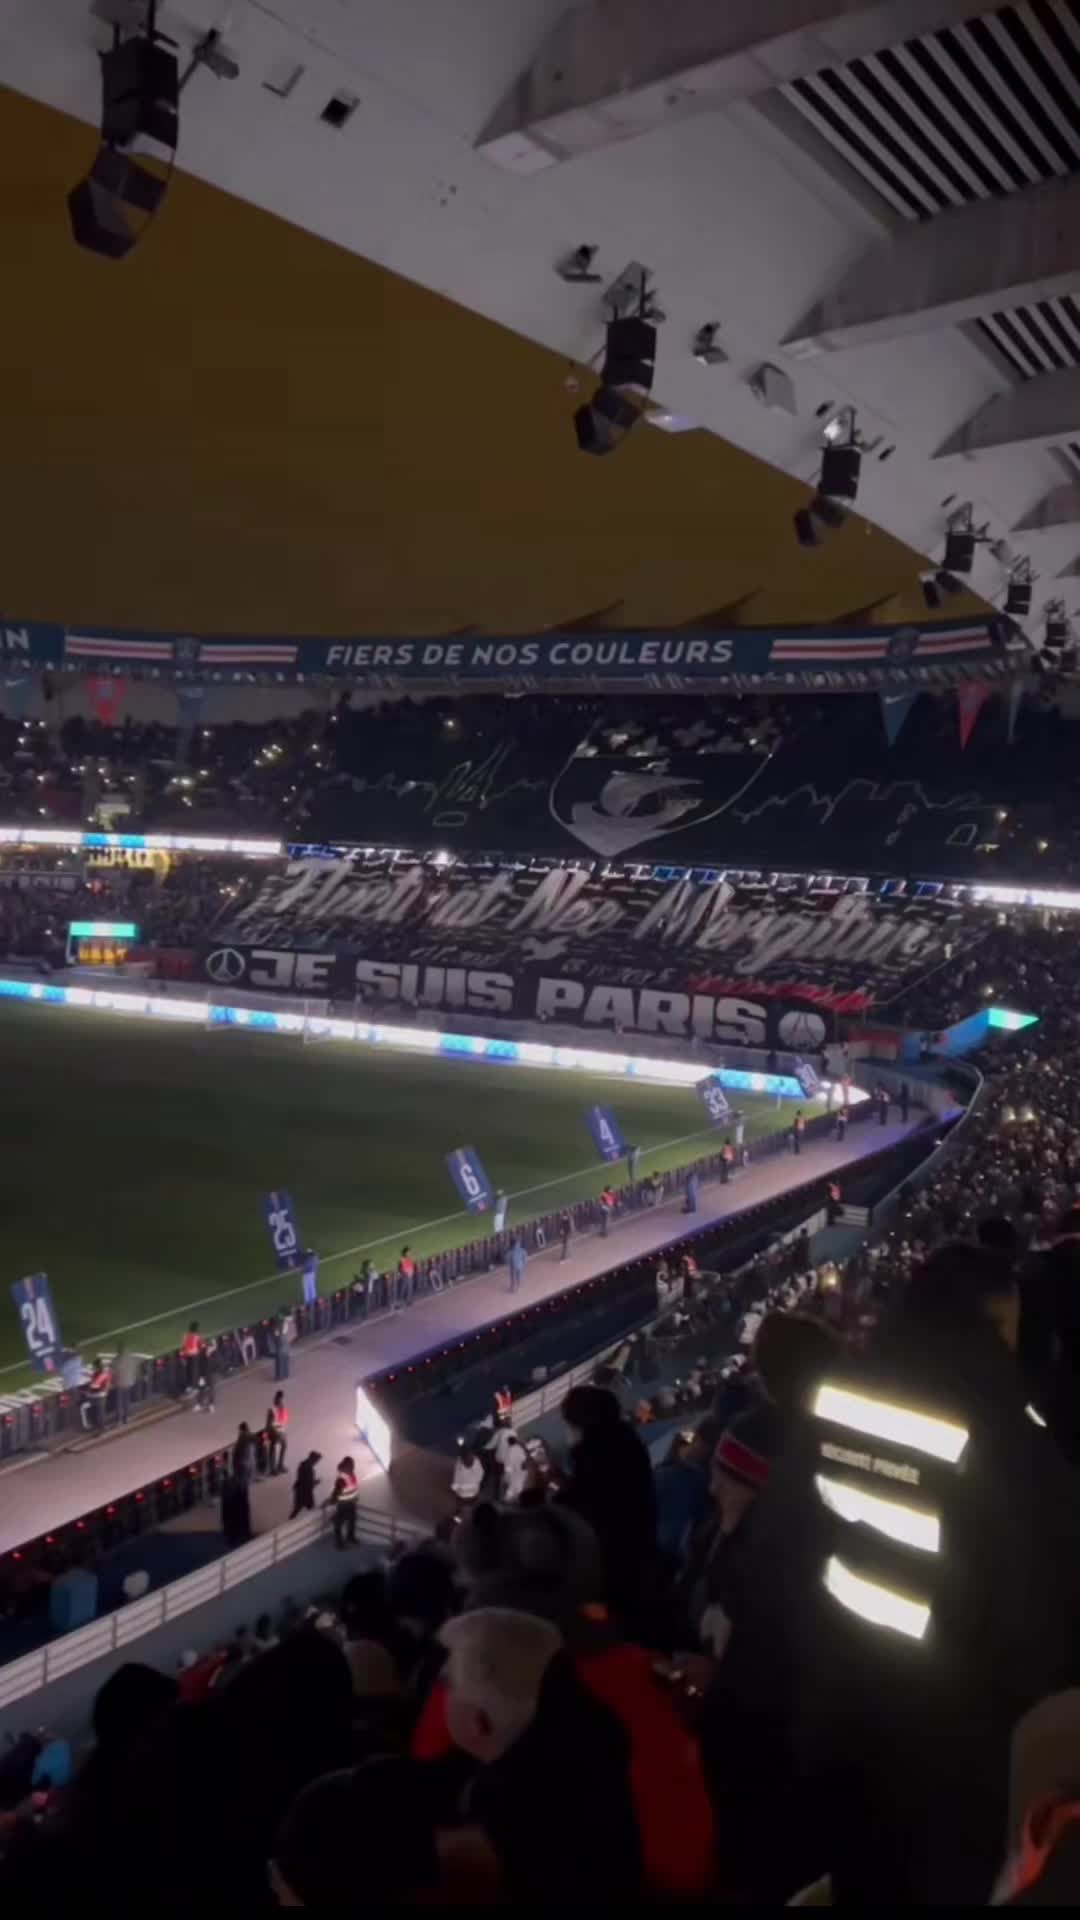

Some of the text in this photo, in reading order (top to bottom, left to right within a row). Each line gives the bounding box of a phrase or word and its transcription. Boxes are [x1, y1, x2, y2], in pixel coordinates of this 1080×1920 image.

[325, 640, 734, 665] FIERS DE NOS COULEURS
[250, 950, 337, 988] JE
[355, 959, 515, 1012] SUIS
[535, 976, 768, 1043] PARIS
[600, 1118, 615, 1145] 4
[460, 1163, 481, 1196] 6
[269, 1208, 297, 1251] 25
[20, 1297, 56, 1350] 24
